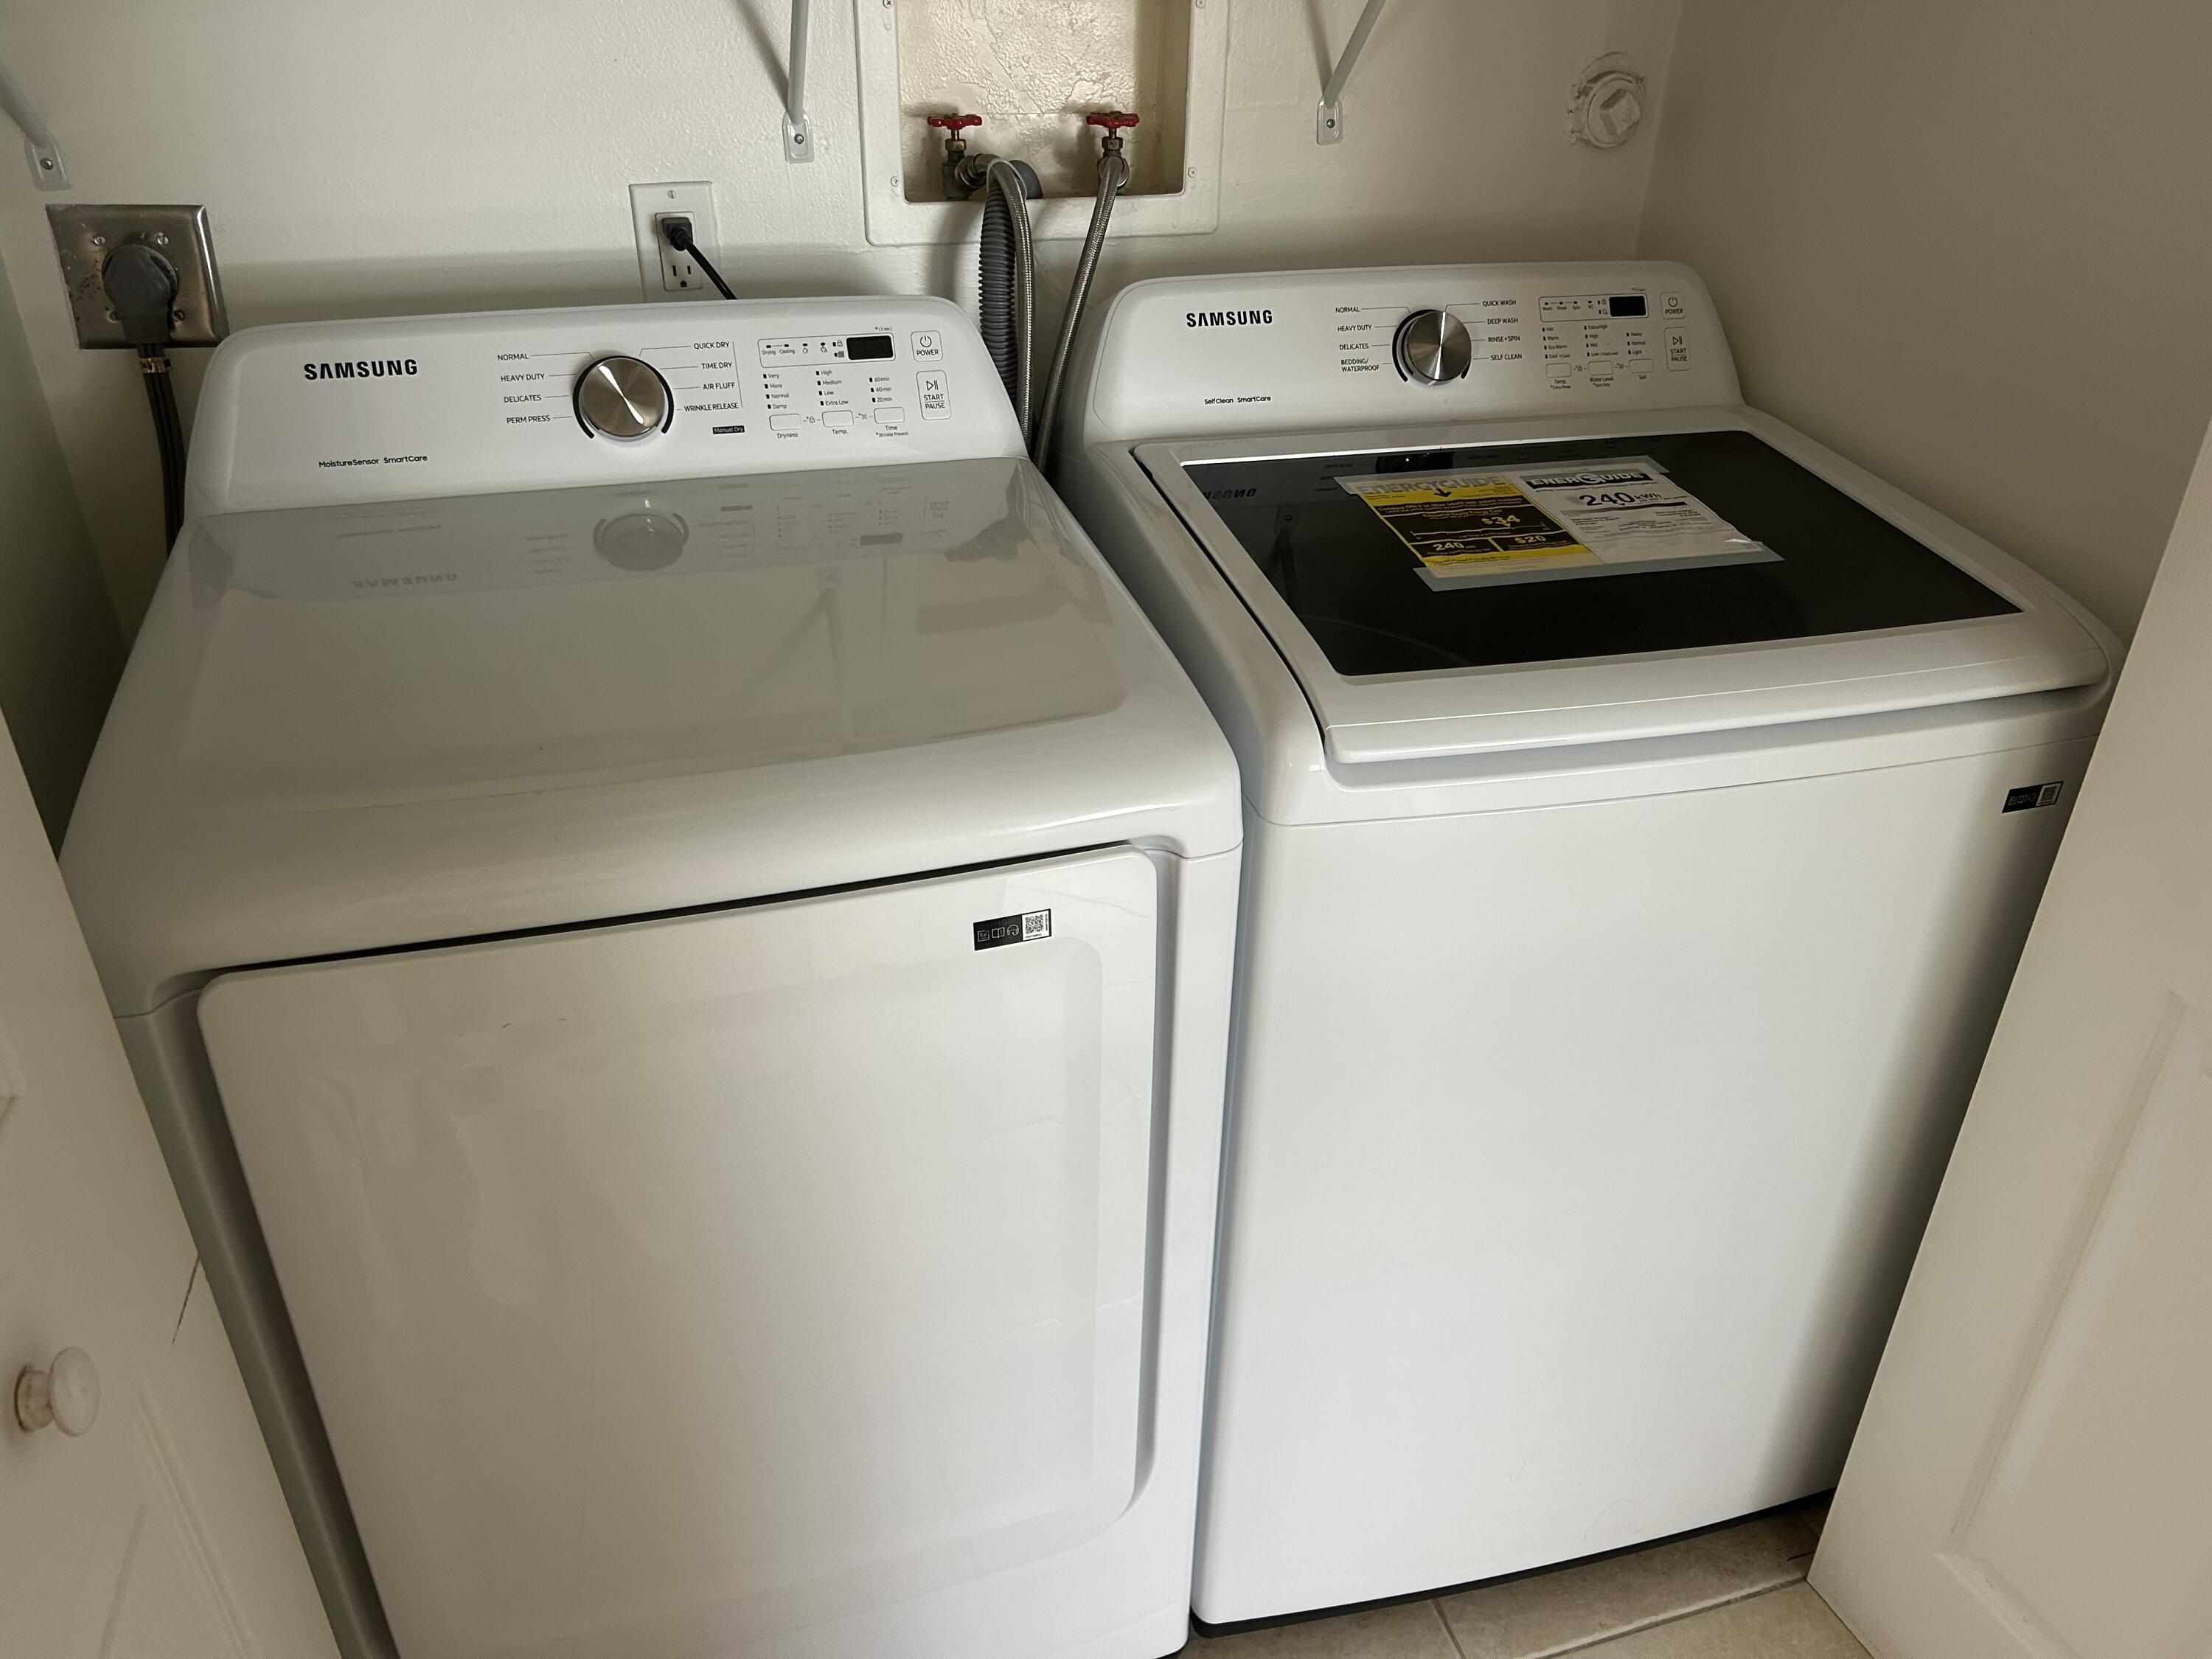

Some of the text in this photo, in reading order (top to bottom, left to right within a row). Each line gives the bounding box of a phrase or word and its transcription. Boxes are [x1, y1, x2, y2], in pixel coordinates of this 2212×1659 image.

[1186, 310, 1273, 327] SAMSUNG
[303, 359, 418, 380] SAMSUNG
[501, 374, 524, 382] HEAVY
[504, 394, 542, 403] DELICATES
[1237, 395, 1271, 403] SmartCare
[684, 404, 712, 412] WRINKLE
[507, 416, 527, 424] PERM
[319, 455, 428, 468] MoistureSensor SmartCare
[1357, 476, 1507, 494] ENERGYGUIDE
[1579, 492, 1635, 506] 240
[1635, 492, 1661, 500] kWh
[1481, 515, 1520, 525] $34
[1514, 535, 1546, 544] $20
[1433, 542, 1464, 551] 240
